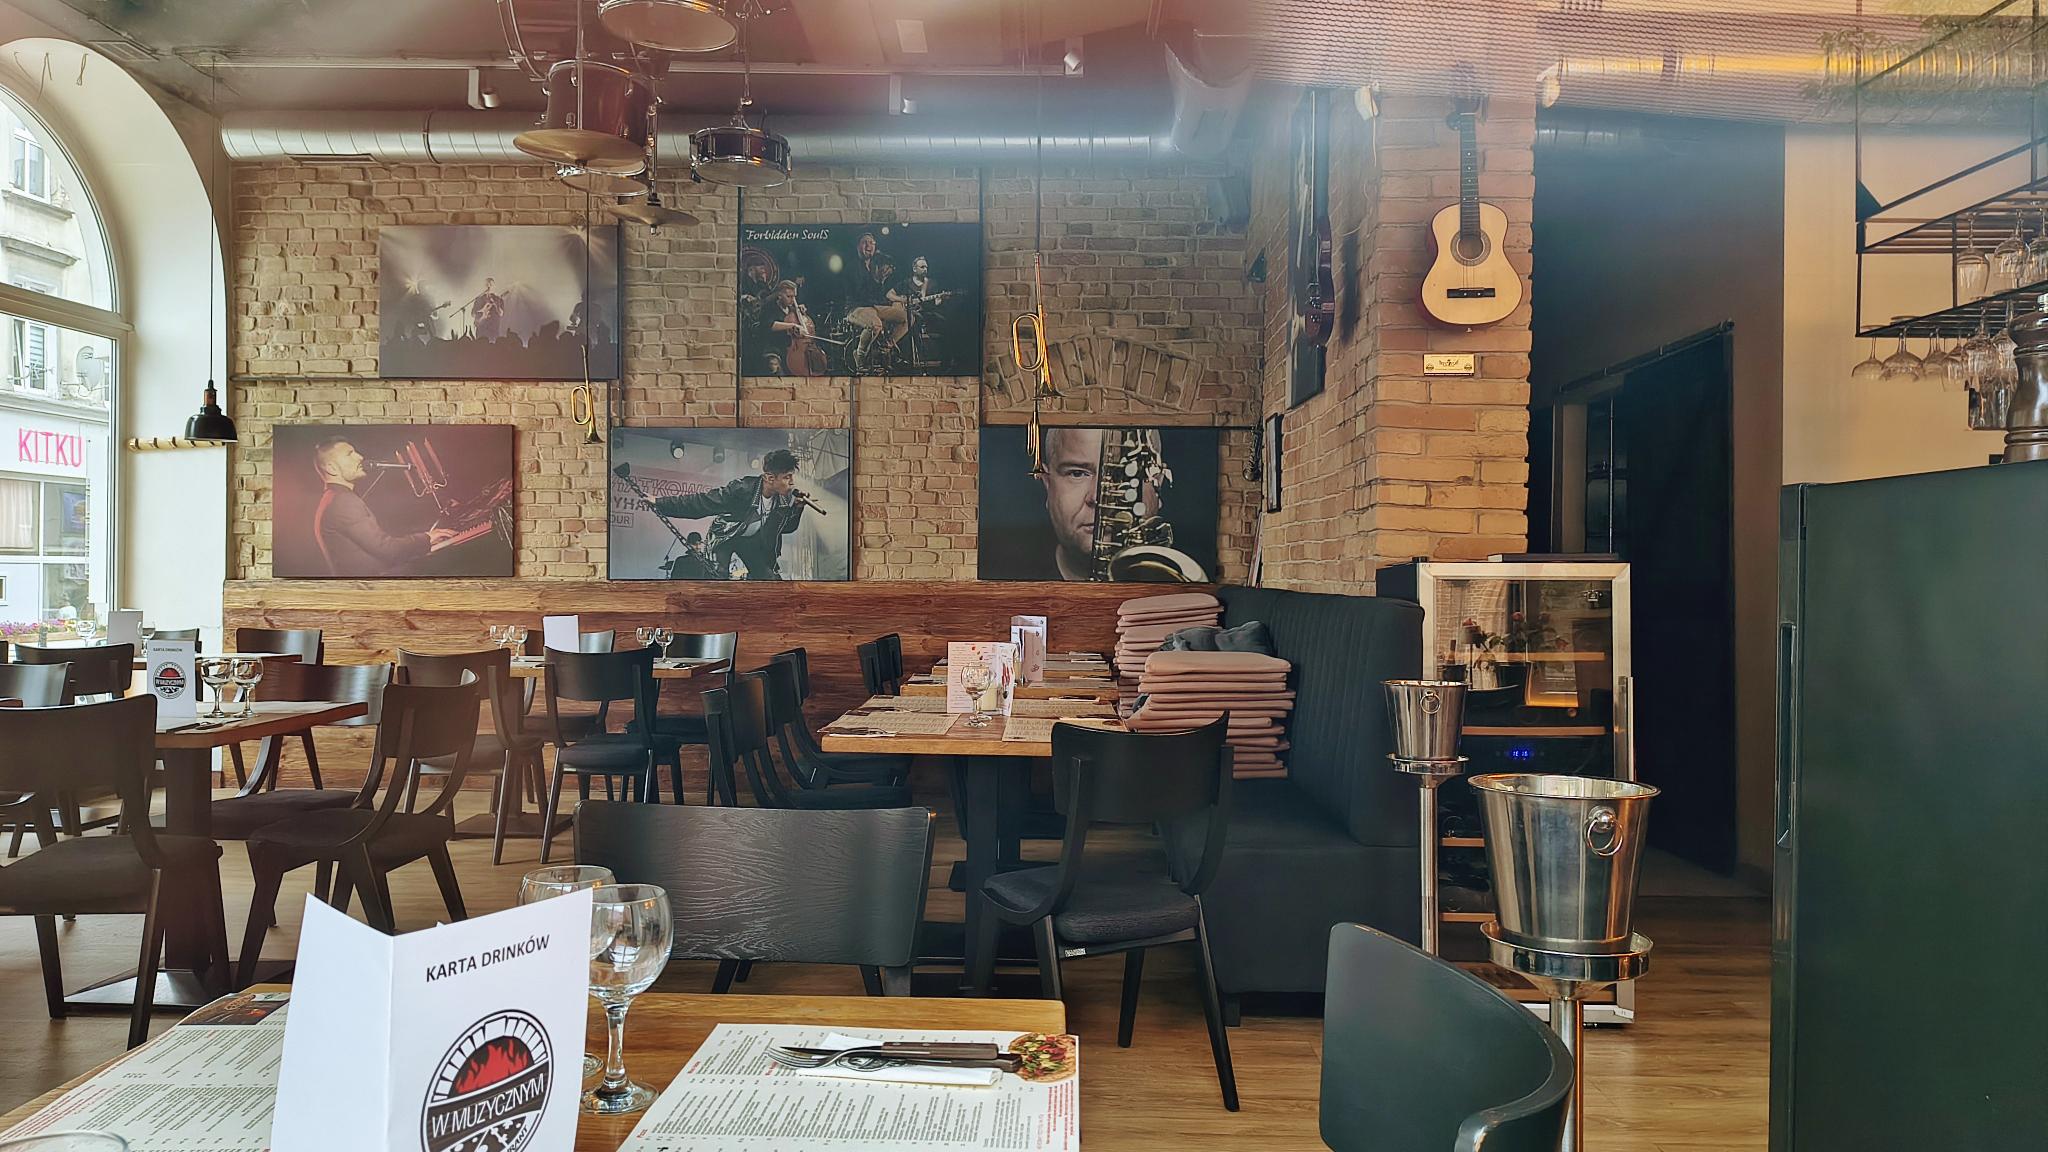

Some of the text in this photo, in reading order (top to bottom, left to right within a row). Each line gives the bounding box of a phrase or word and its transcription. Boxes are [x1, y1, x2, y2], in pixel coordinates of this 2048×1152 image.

[745, 229, 799, 240] Forbidden
[18, 428, 82, 467] KITKU
[426, 934, 550, 982] KARTA DRINKÓW
[431, 1073, 545, 1139] W MUZYCZNYM
